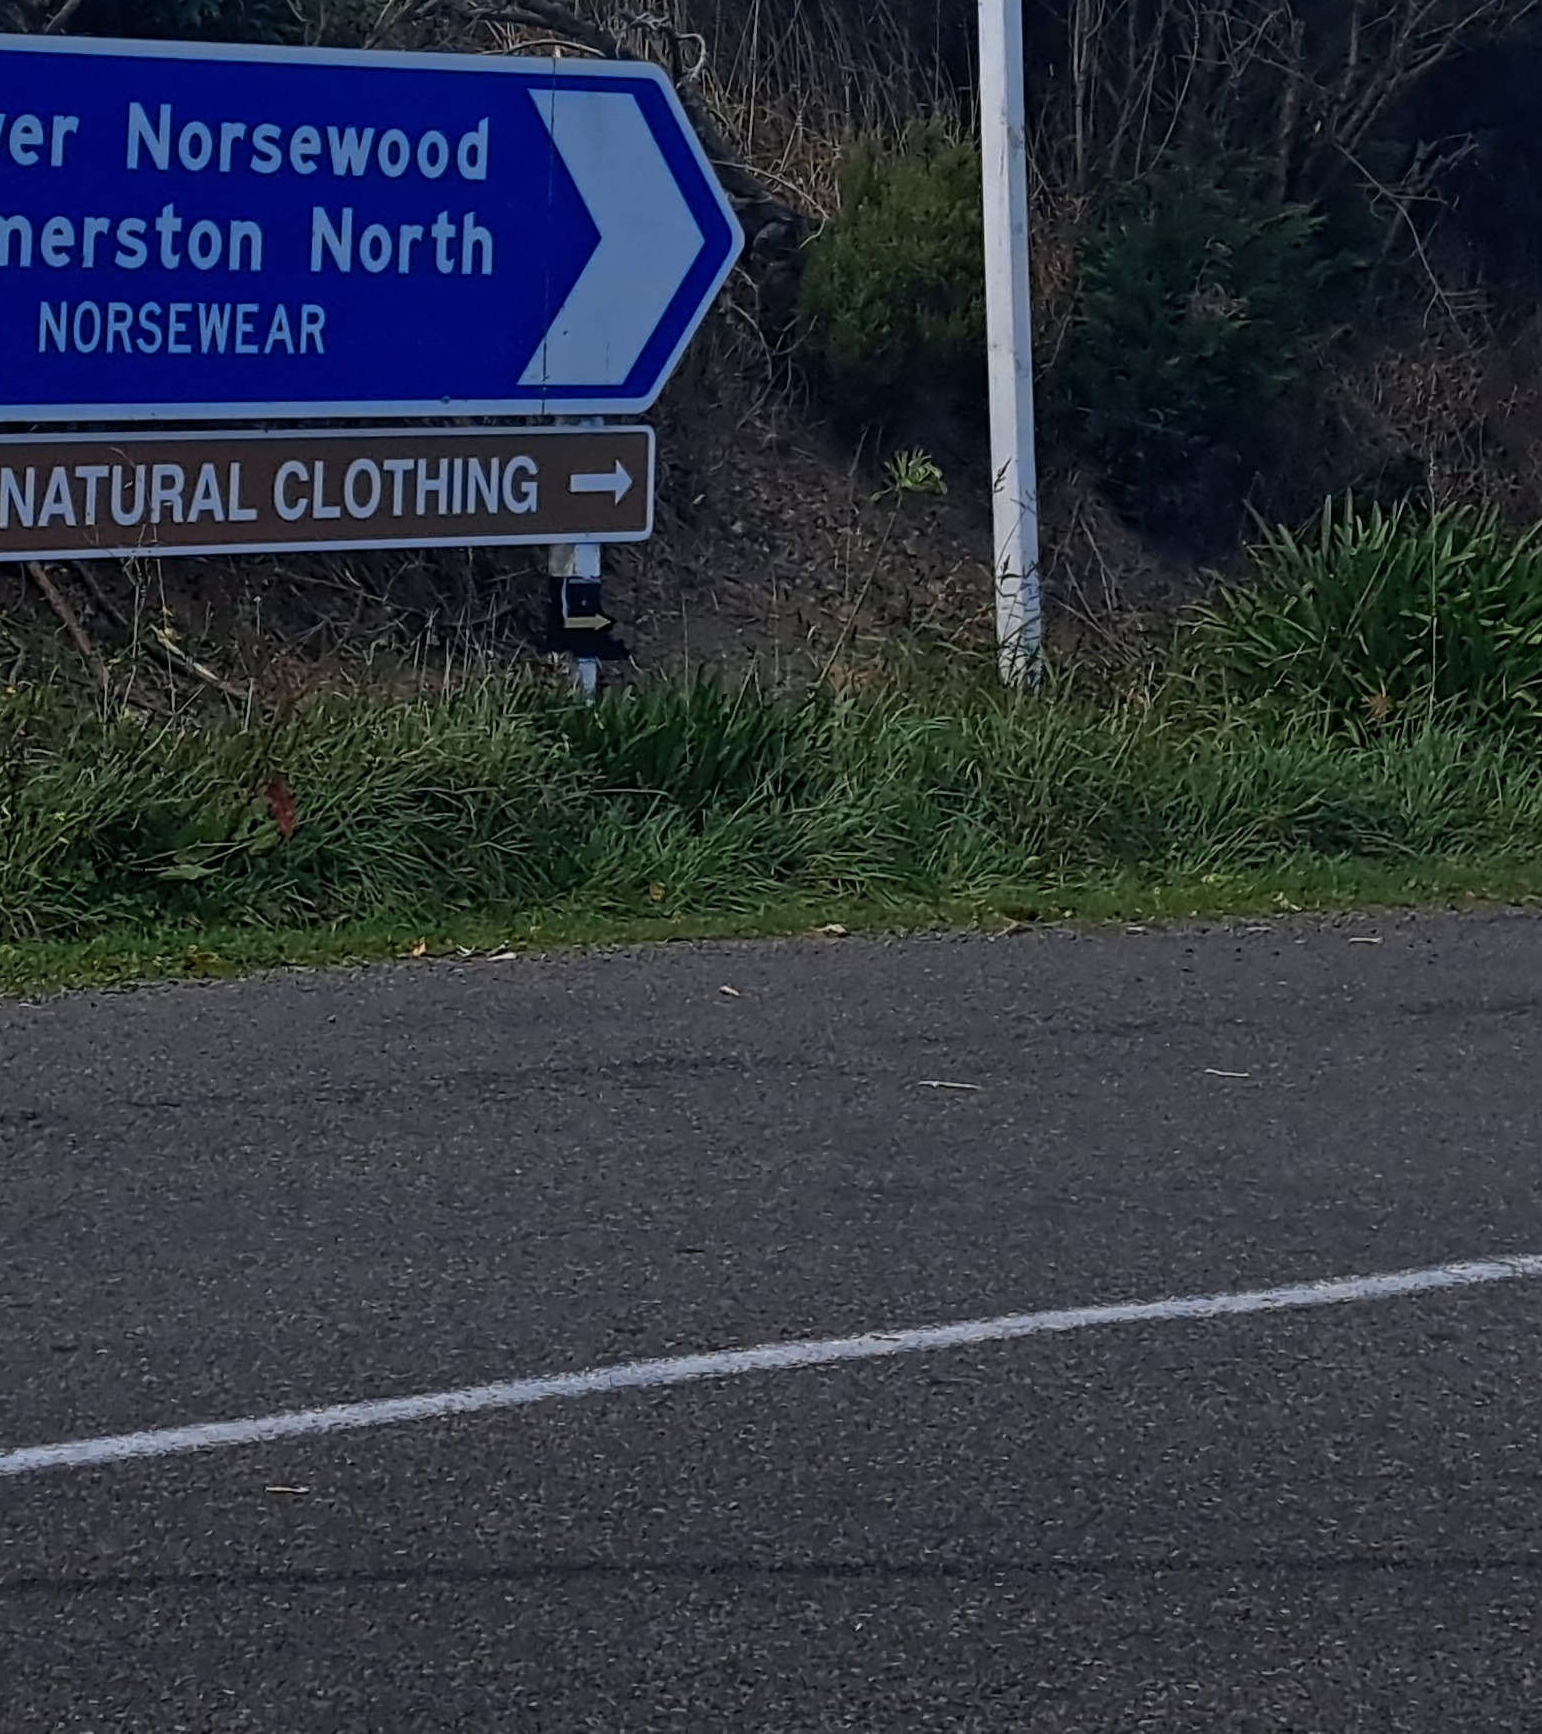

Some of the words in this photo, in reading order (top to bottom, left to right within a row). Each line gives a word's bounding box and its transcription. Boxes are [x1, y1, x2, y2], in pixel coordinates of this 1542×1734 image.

[126, 103, 490, 181] Norsewood
[311, 207, 493, 276] North
[38, 300, 326, 355] NORSEWEAR
[0, 462, 258, 527] NATURAL
[272, 456, 539, 520] CLOTHING
